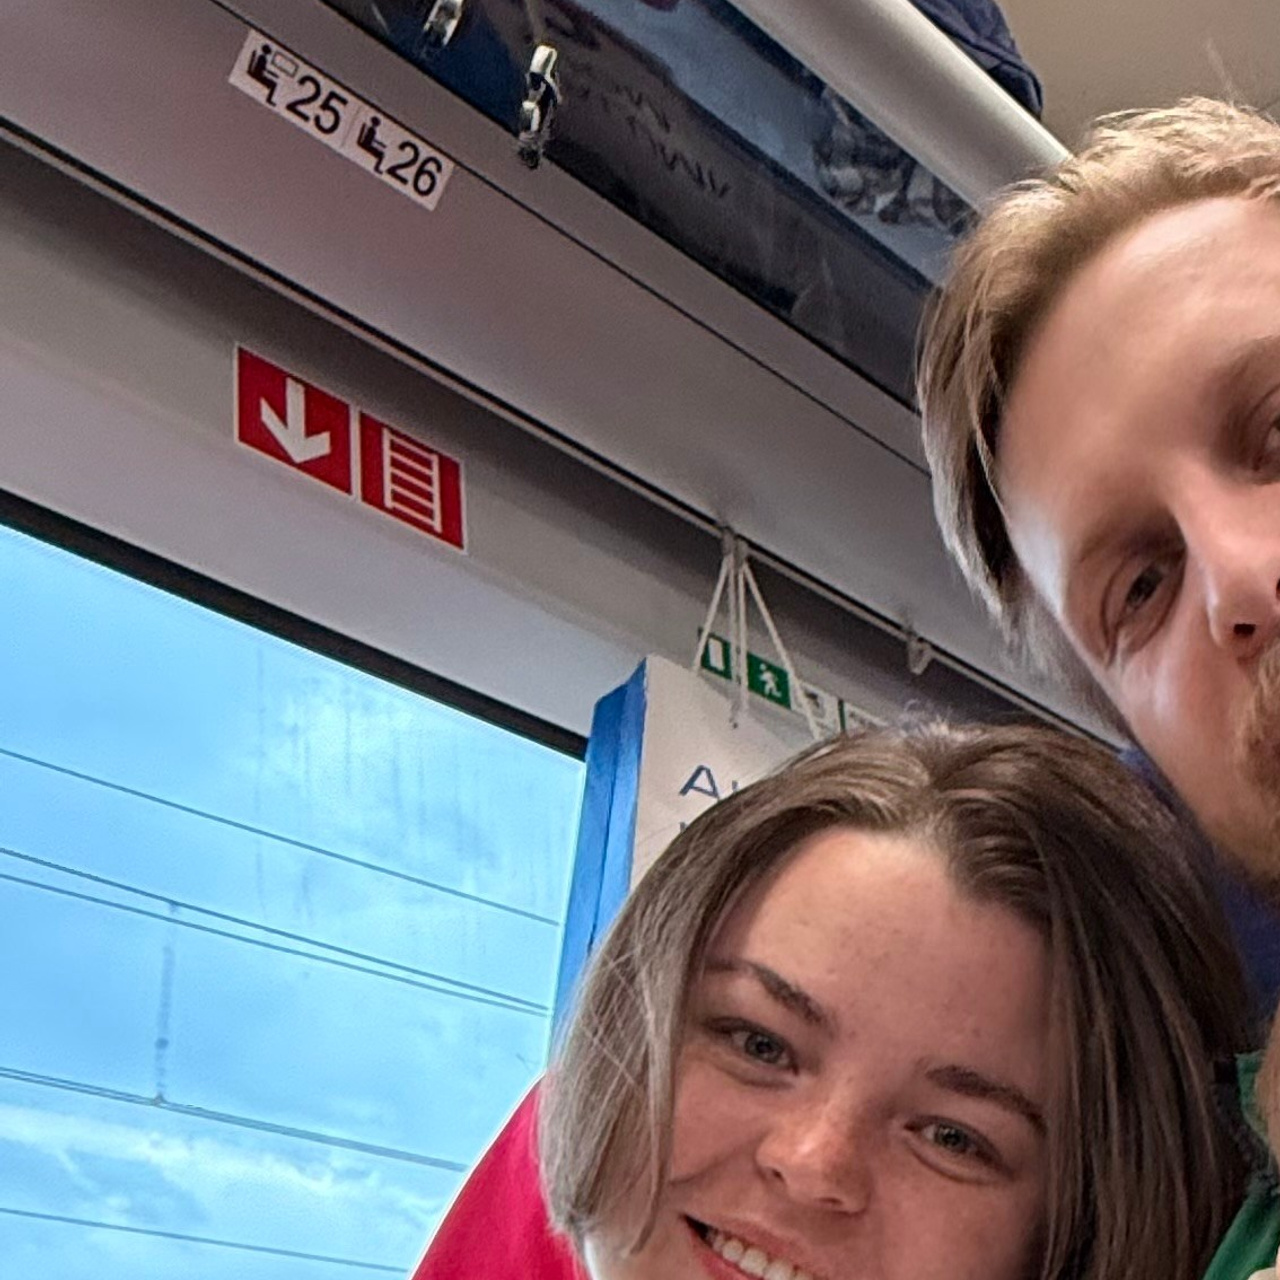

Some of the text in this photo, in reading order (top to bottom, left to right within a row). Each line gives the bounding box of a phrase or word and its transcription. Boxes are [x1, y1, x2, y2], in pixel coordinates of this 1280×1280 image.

[285, 75, 442, 197] 25 26
[679, 764, 738, 800] A
